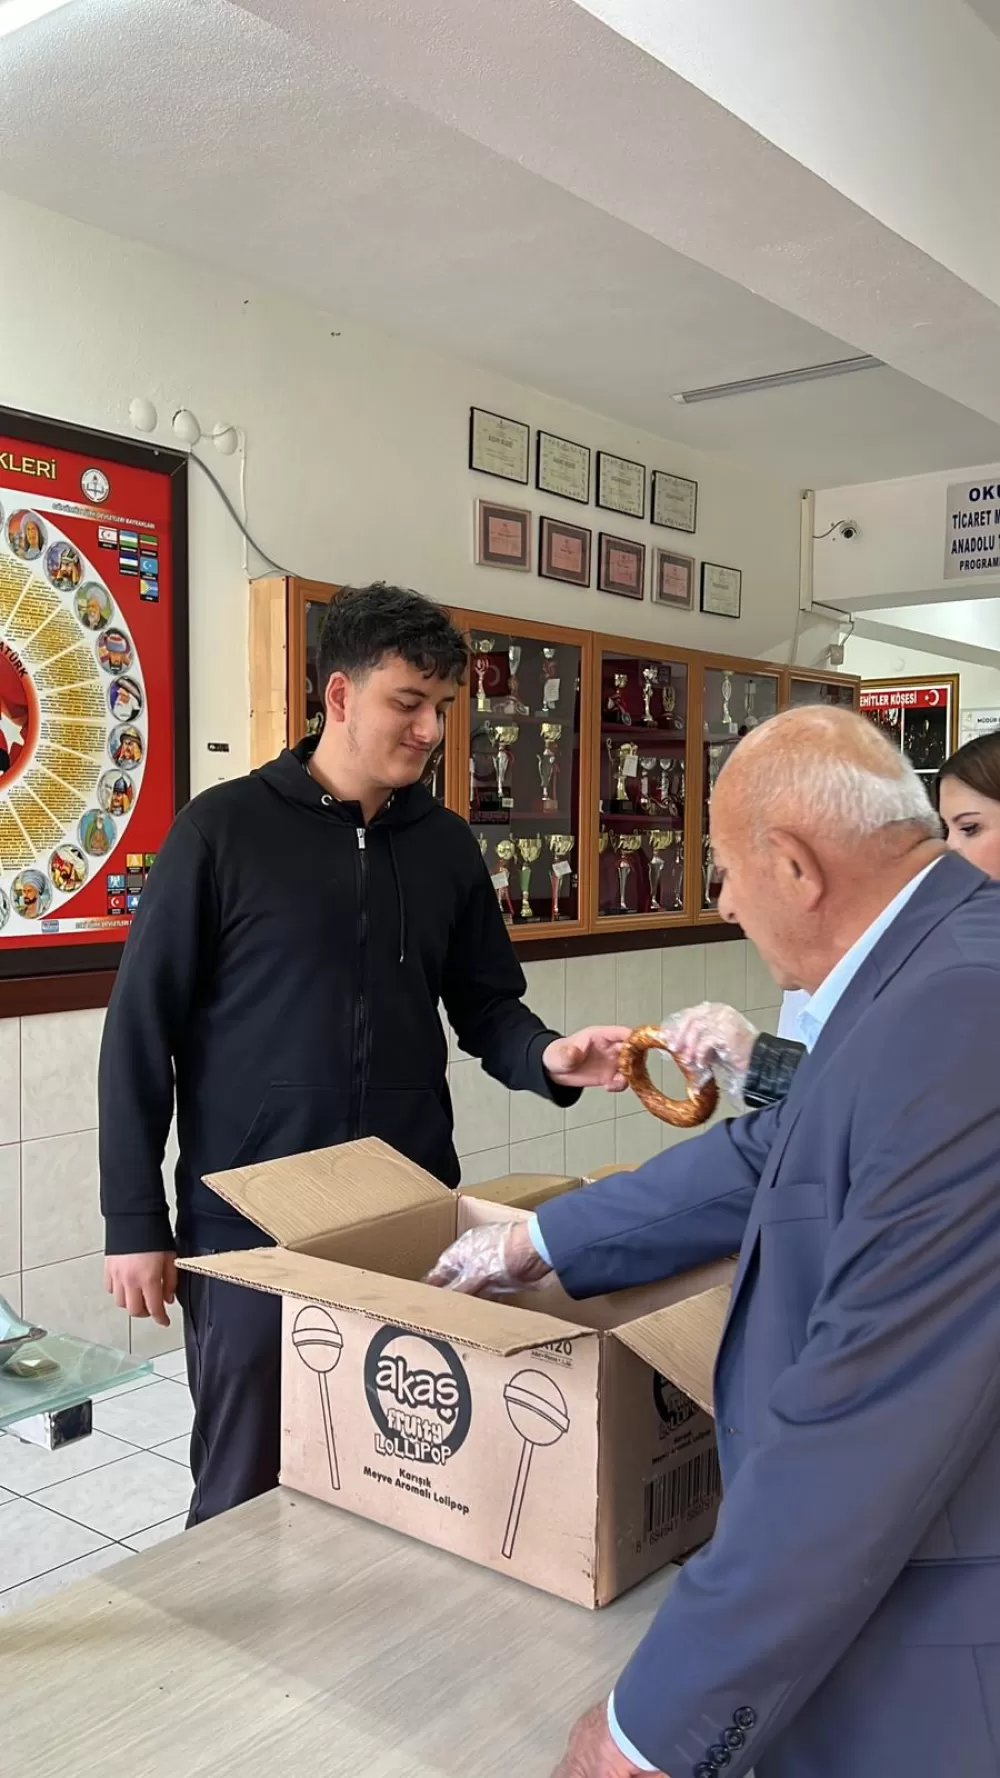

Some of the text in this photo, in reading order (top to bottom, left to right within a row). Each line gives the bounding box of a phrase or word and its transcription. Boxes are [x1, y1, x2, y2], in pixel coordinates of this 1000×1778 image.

[969, 484, 1000, 502] OK
[952, 510, 992, 530] TİCARET
[951, 535, 995, 555] ANADOLU
[399, 1468, 432, 1489] Karışık
[363, 1466, 470, 1516] Meyve Aromalı Lolipop
